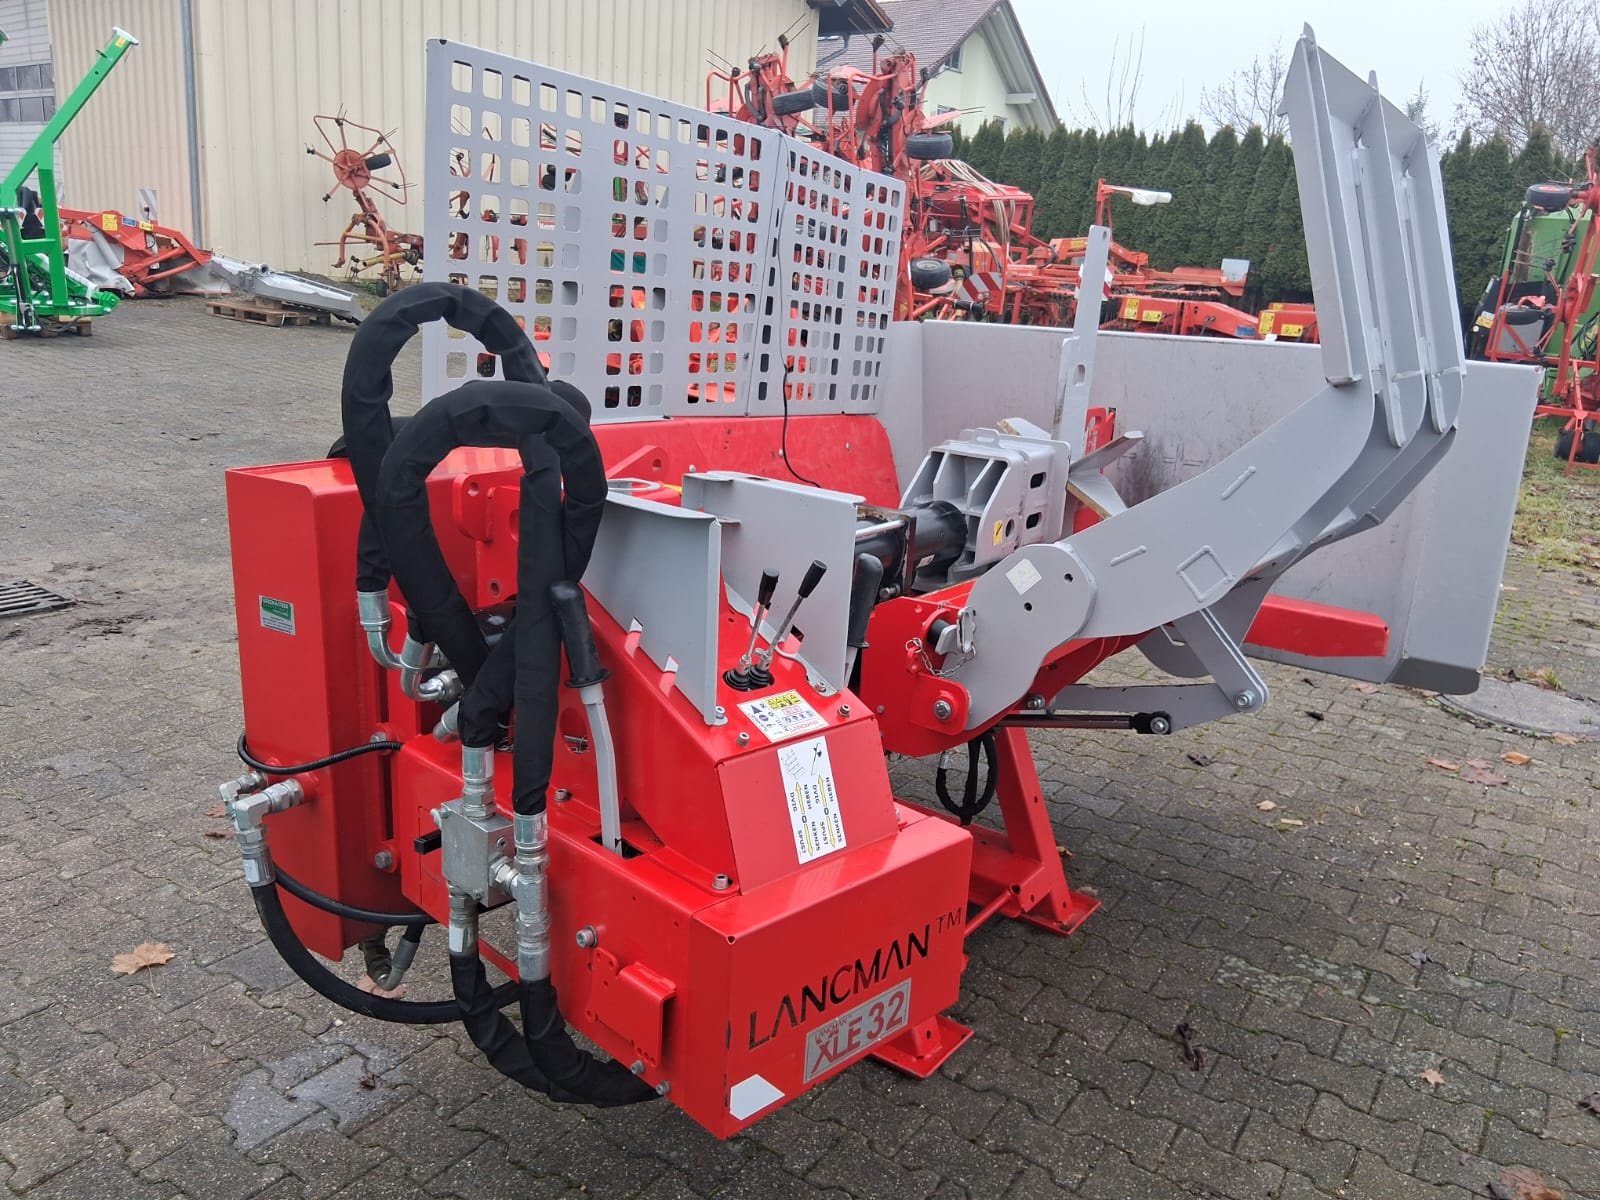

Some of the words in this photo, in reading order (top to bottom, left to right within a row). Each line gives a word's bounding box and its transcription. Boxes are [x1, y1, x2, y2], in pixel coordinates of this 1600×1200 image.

[804, 784, 812, 810] HEBEN
[812, 784, 820, 804] DVIG
[820, 821, 828, 845] SPUST
[798, 829, 806, 854] SPUST
[811, 821, 820, 851] SENKEN
[749, 924, 930, 1050] LANCMAN
[811, 1015, 863, 1074] XLE
[867, 990, 904, 1041] 32
